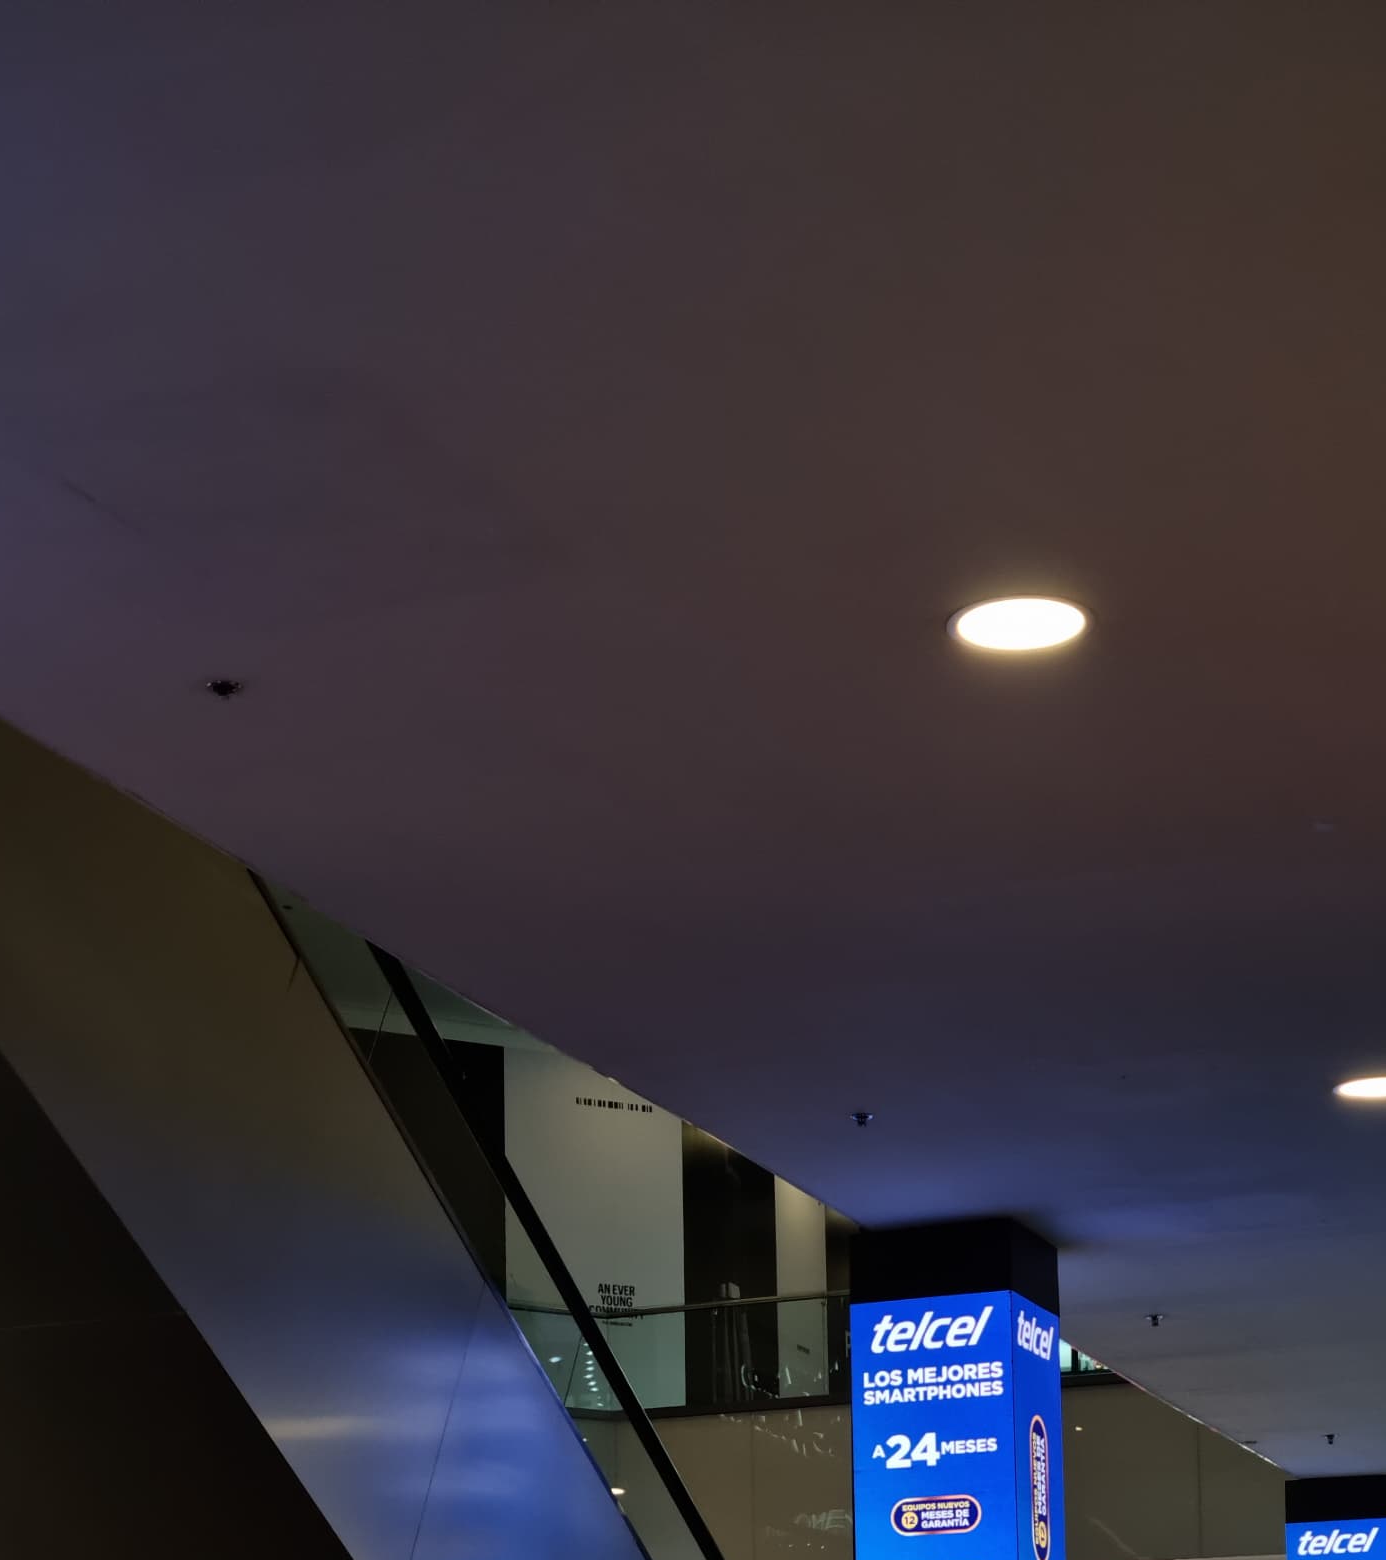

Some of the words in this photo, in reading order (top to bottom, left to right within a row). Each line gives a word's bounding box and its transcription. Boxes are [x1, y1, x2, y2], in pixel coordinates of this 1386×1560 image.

[597, 1283, 611, 1295] AN
[612, 1284, 635, 1296] EVER
[601, 1295, 633, 1307] YOUNG
[870, 1305, 994, 1354] telcel
[1016, 1310, 1055, 1361] telcel
[863, 1369, 903, 1389] LOS
[907, 1361, 1004, 1385] MEJORES
[863, 1380, 1004, 1406] SMARTPHONES
[886, 1432, 941, 1469] 24
[941, 1437, 998, 1455] MESES
[901, 1503, 936, 1512] EQUIPOS
[937, 1501, 970, 1510] NUEVOS
[921, 1510, 954, 1520] MESES
[955, 1509, 970, 1518] DE
[904, 1516, 916, 1525] 12
[921, 1517, 970, 1528] GARANTÍA
[1297, 1527, 1379, 1556] telcel
